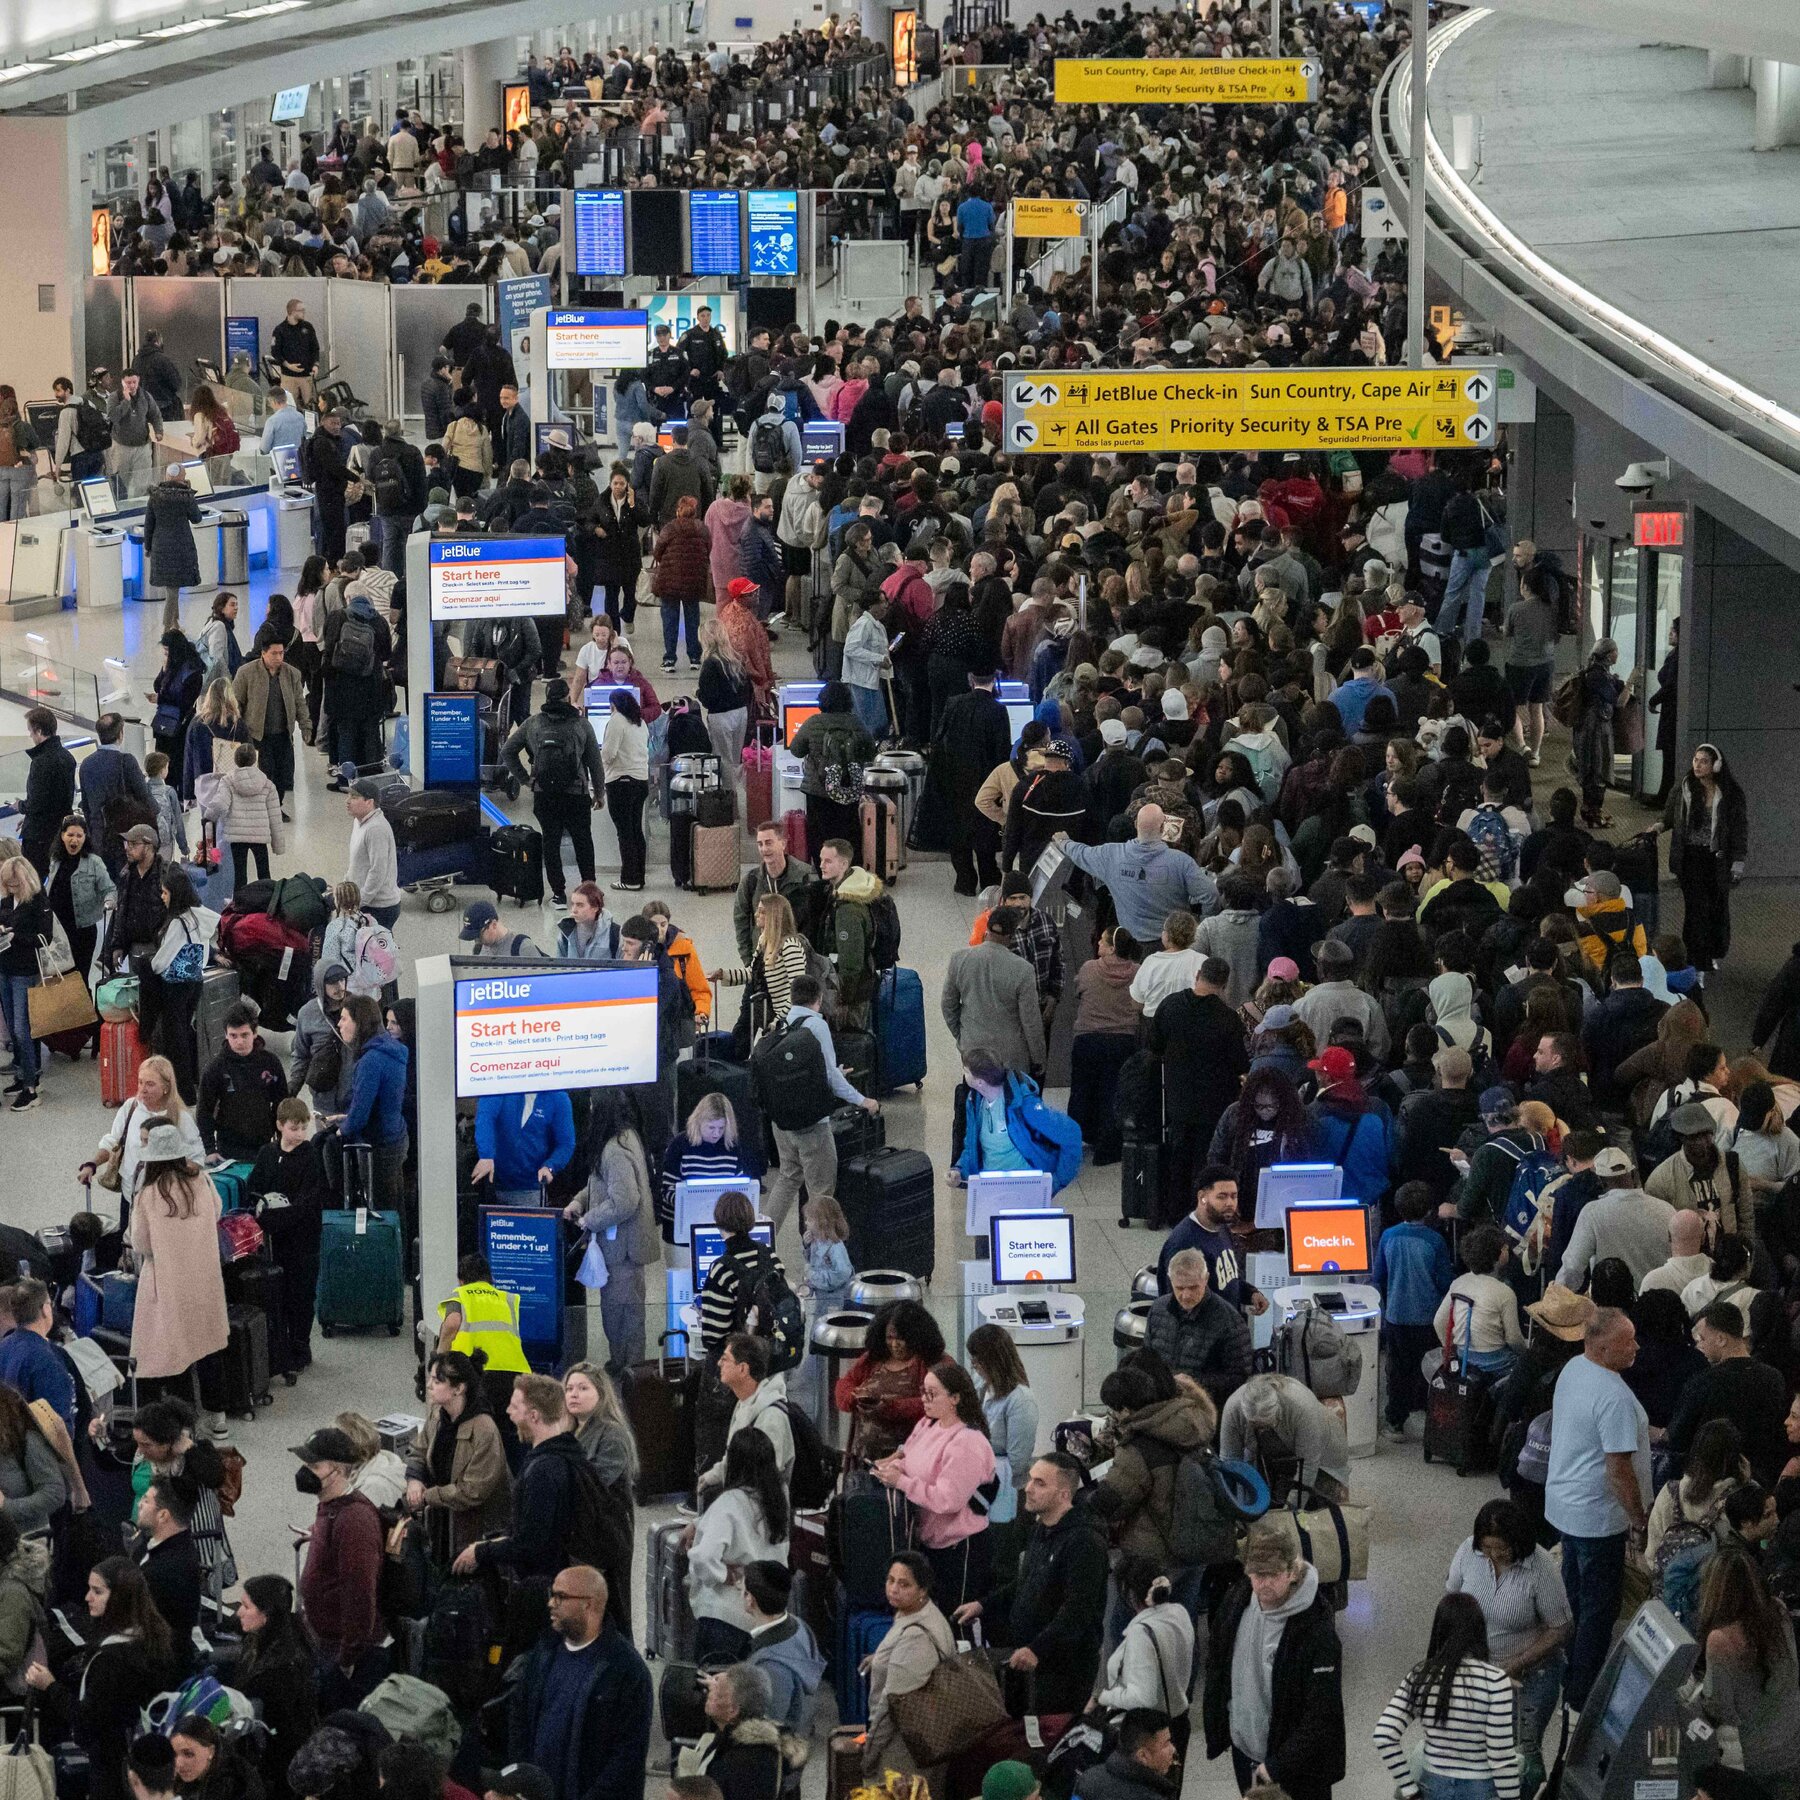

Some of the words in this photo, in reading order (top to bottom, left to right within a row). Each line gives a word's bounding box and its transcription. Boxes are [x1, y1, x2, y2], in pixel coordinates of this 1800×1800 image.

[1084, 67, 1102, 76] Sun
[1106, 67, 1149, 77] Country,
[1152, 67, 1177, 77] Cape
[1199, 66, 1236, 76] JetBlue
[1238, 66, 1281, 76] Check-in
[1135, 85, 1172, 95] Priority
[1175, 84, 1215, 95] Security
[1218, 84, 1226, 93] &
[1228, 84, 1248, 93] TSA
[1250, 84, 1267, 93] Pre
[507, 282, 535, 291] Everything
[512, 292, 524, 300] your
[524, 298, 536, 306] your
[554, 314, 585, 326] jetBlue
[556, 332, 579, 341] Start
[580, 332, 600, 340] here
[1094, 385, 1158, 401] JetBlue
[1163, 384, 1238, 400] Check-in
[1250, 384, 1281, 399] Sun
[1286, 382, 1356, 402] Country,
[1361, 382, 1402, 401] Cape
[1406, 382, 1432, 397] Air
[1075, 419, 1100, 435] All
[1106, 420, 1158, 434] Gates
[1170, 418, 1234, 437] Priority
[1240, 416, 1311, 436] Security
[1316, 416, 1330, 432] &
[1335, 416, 1370, 432] TSA
[1376, 416, 1402, 431] Pre
[1075, 439, 1099, 447] Todas
[1100, 439, 1112, 447] las
[1114, 438, 1145, 448] puertas
[1318, 436, 1360, 444] Seguridad
[1362, 435, 1402, 443] Prioritaria
[1641, 512, 1680, 544] EXIT
[441, 545, 480, 560] jetBlue
[442, 570, 472, 581] Start
[475, 570, 500, 580] here
[442, 595, 482, 604] Comenzar
[469, 981, 530, 1006] jetBlue
[470, 1021, 516, 1038] Start
[522, 1020, 561, 1034] here
[470, 1039, 503, 1048] Check-in
[508, 1038, 531, 1046] Select
[556, 1034, 574, 1042] Print
[575, 1033, 588, 1042] bag
[590, 1032, 607, 1041] tags
[470, 1060, 532, 1074] Comenzar
[490, 1219, 514, 1228] jetBlue
[490, 1232, 538, 1242] Remember,
[1303, 1236, 1340, 1248] Check
[1342, 1235, 1355, 1246] in.
[496, 1242, 521, 1250] under
[535, 1244, 549, 1252] up!
[1008, 1240, 1032, 1250] Start
[1034, 1240, 1057, 1250] here.
